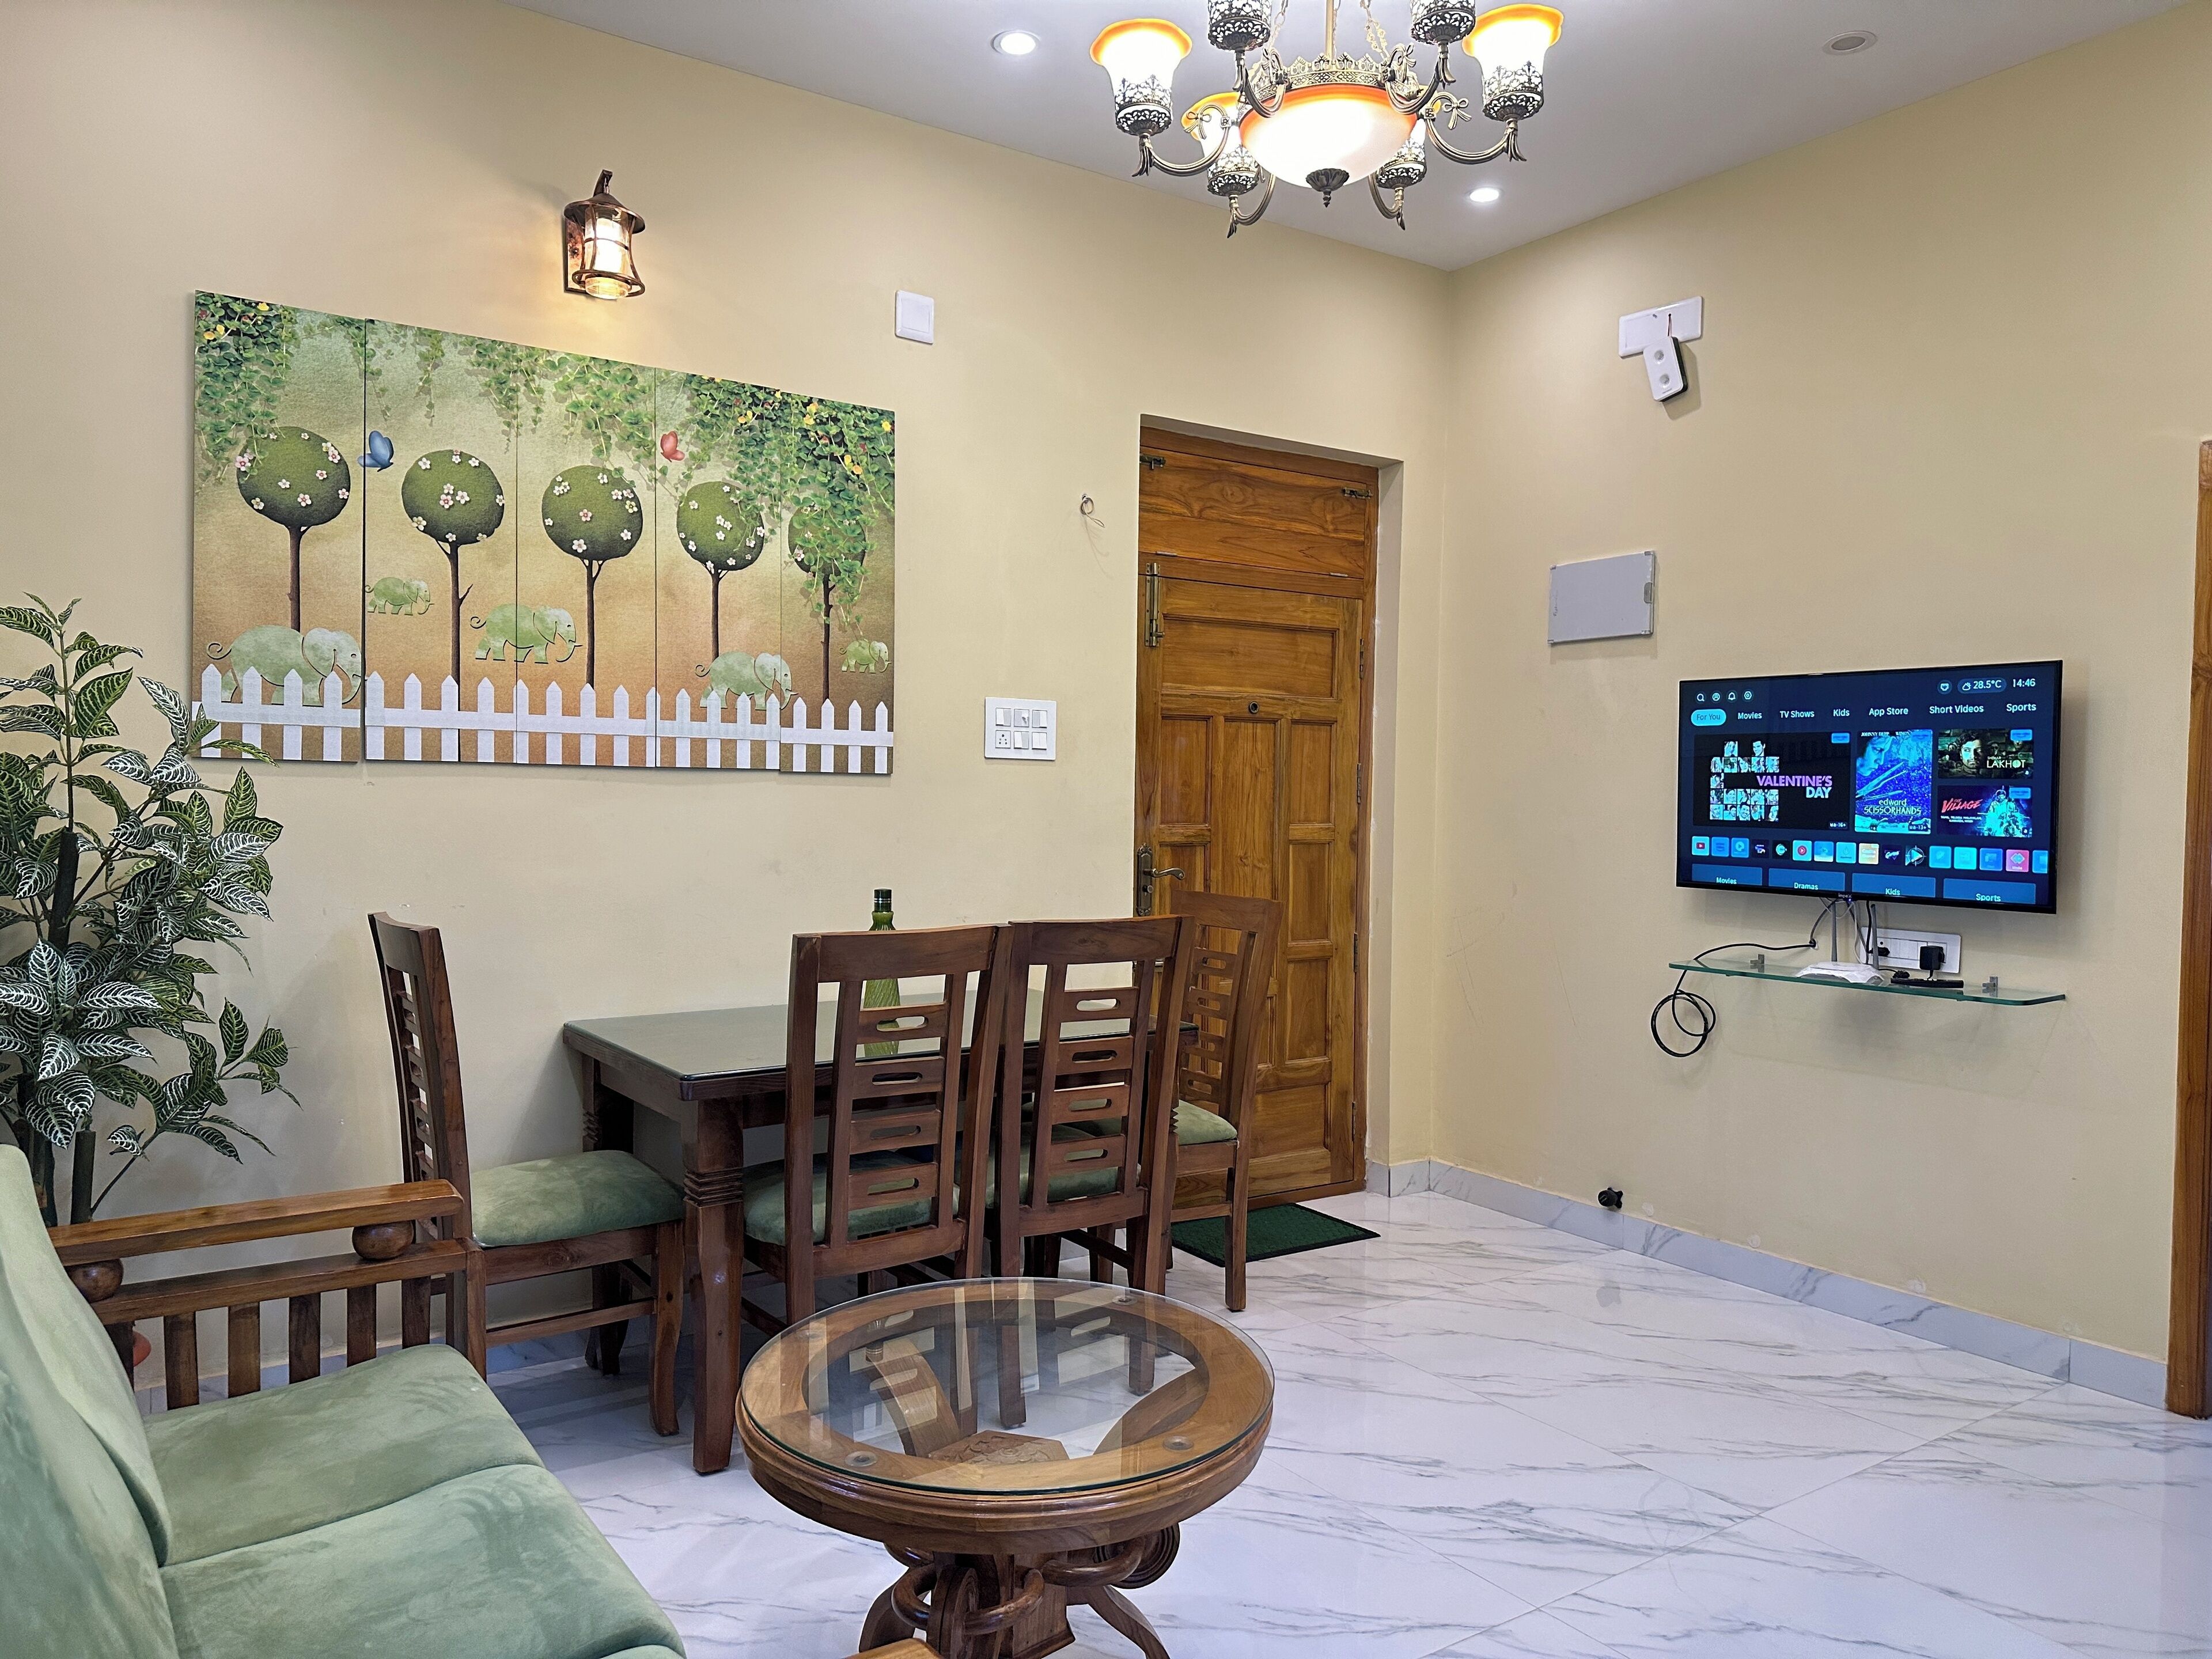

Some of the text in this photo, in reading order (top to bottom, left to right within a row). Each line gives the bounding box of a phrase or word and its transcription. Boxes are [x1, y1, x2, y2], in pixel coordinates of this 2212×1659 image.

[1973, 680, 2002, 689] 28.5°C
[2012, 679, 2036, 687] 14:46
[1869, 707, 1908, 717] App Store
[1929, 704, 1984, 714] Short Videos
[2006, 703, 2037, 712] Sports
[1737, 711, 1762, 719] Movies
[1790, 710, 1815, 718] Shows
[1833, 709, 1850, 717] Kids
[1987, 759, 2026, 768] LAKHOT
[1756, 775, 1832, 787] VALENTINE'S
[1806, 787, 1832, 798] DAY
[1878, 798, 1907, 806] edward
[1864, 806, 1922, 815] SCISSORHANDS
[1716, 877, 1737, 885] Movies
[1794, 882, 1819, 890] Dramas
[1885, 888, 1900, 896] Kids
[1976, 893, 2001, 902] Sports
